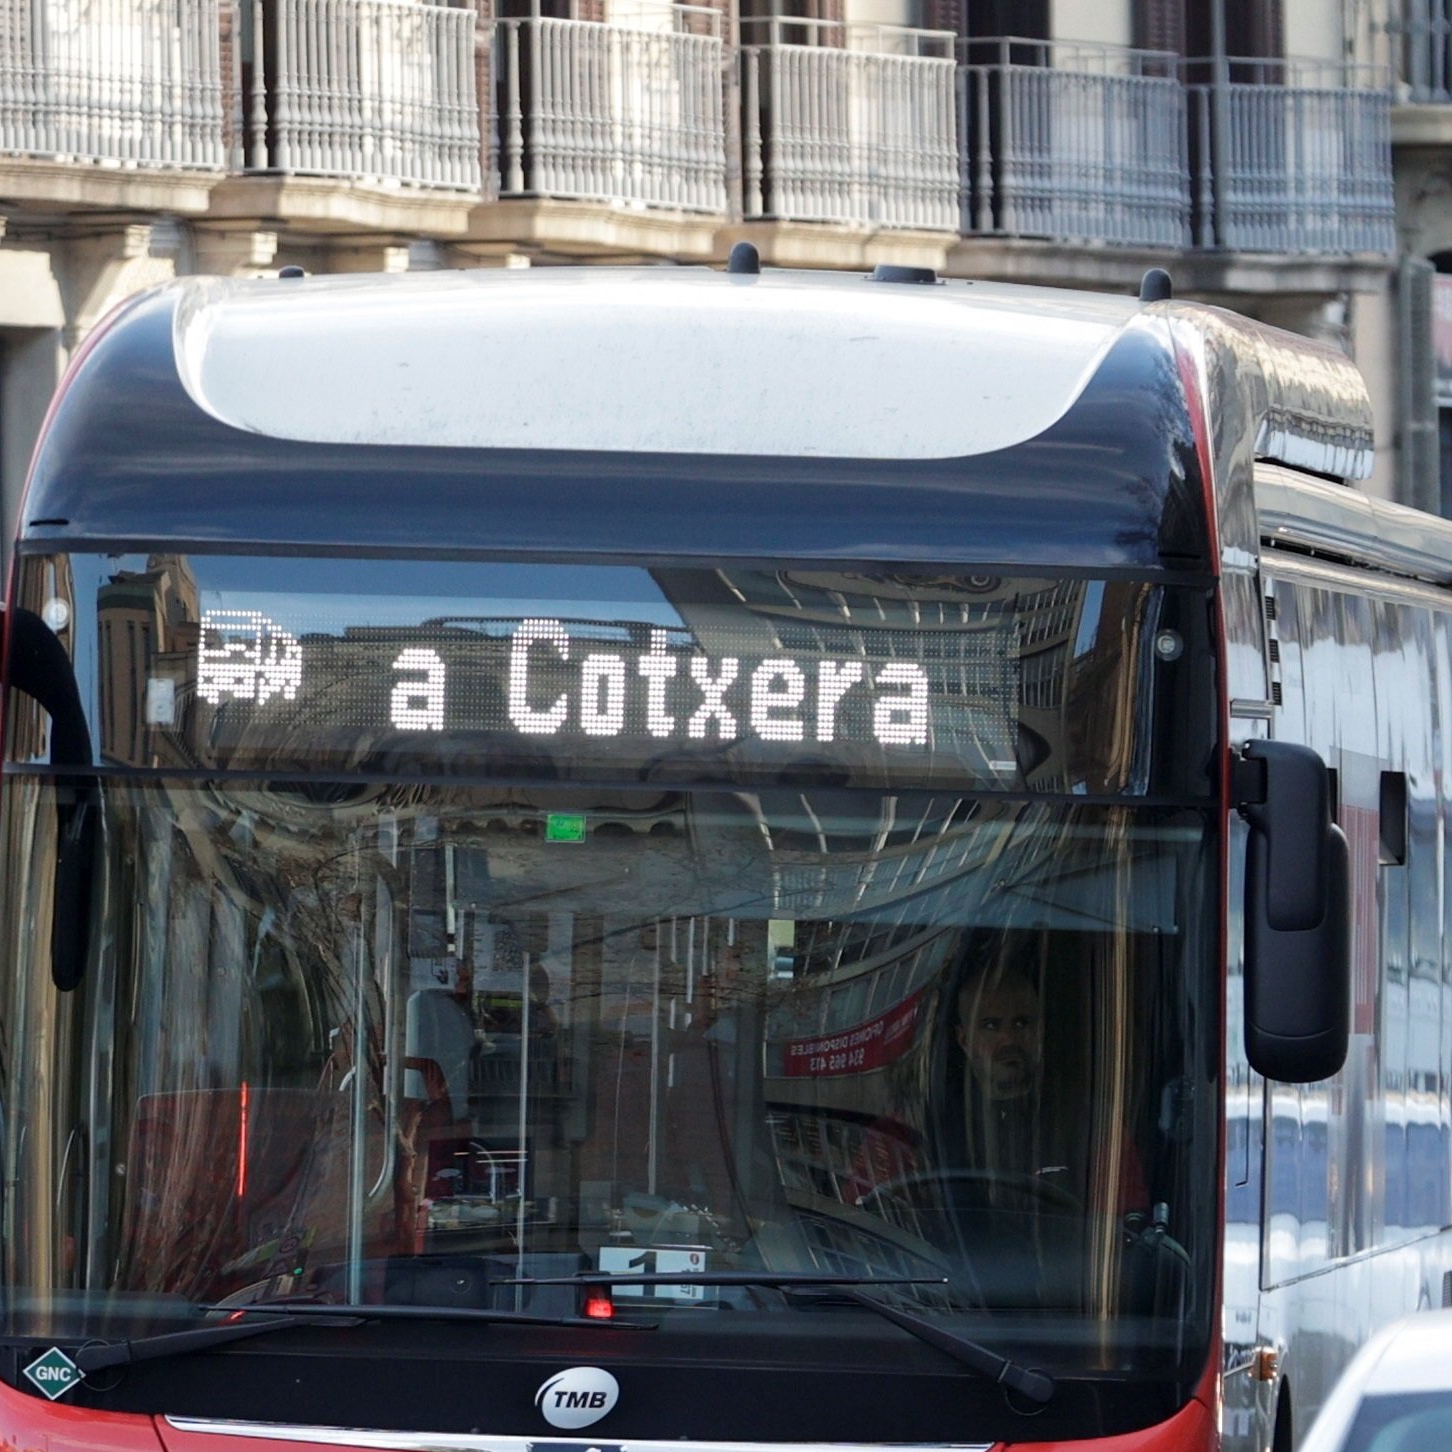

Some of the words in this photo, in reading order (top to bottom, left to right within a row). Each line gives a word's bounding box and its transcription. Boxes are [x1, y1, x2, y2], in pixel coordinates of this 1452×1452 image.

[390, 648, 445, 731] a
[509, 618, 928, 745] Cotxera
[35, 1366, 71, 1382] GNC
[554, 1391, 607, 1408] TMB
